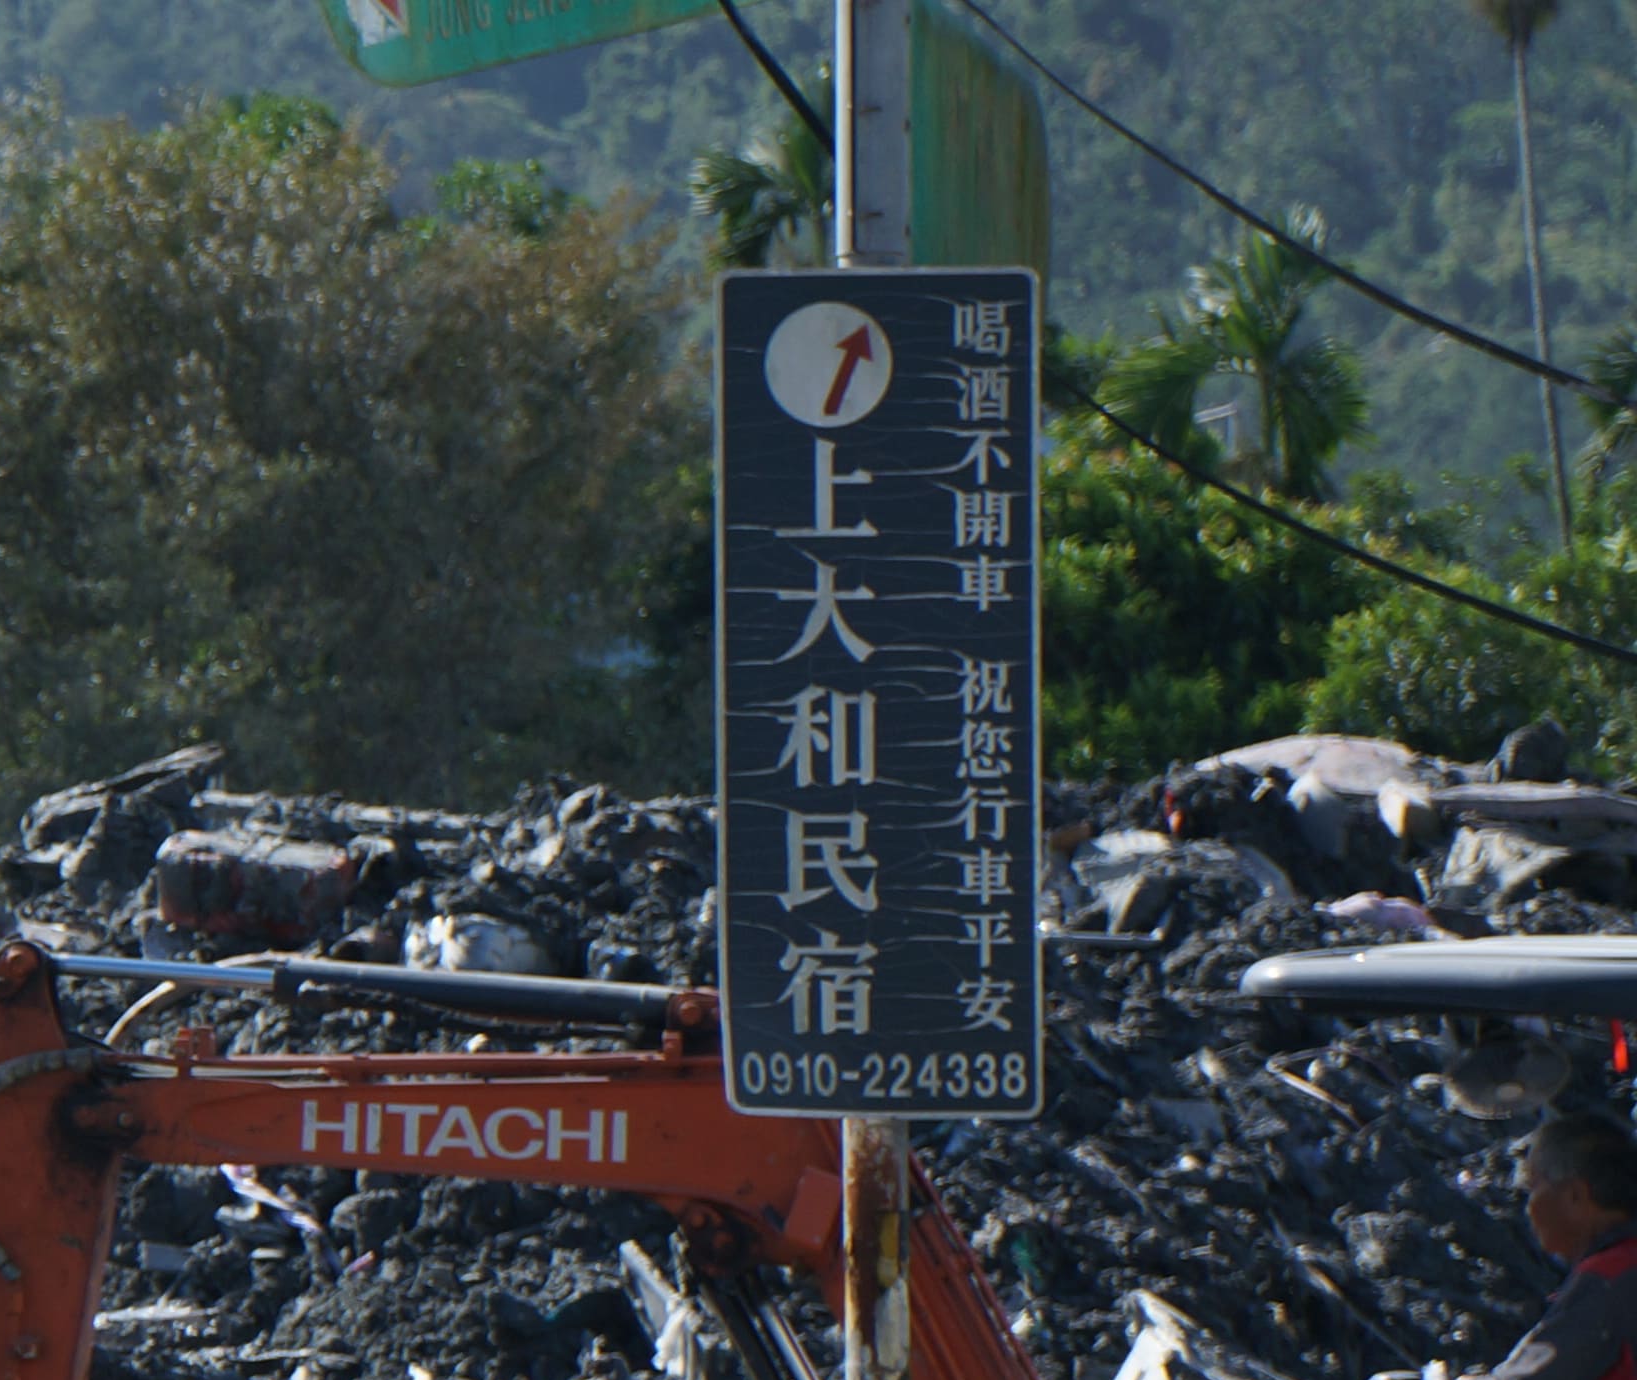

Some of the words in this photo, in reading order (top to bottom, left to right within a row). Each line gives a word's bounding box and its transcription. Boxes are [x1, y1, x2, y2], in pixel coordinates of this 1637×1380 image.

[953, 299, 1013, 612] 喝酒不開車
[774, 437, 880, 1036] 上大和民宿
[954, 658, 1013, 1033] 祝您行車平安
[300, 1099, 628, 1164] HITACHI
[742, 1050, 1028, 1100] 0910-224338
